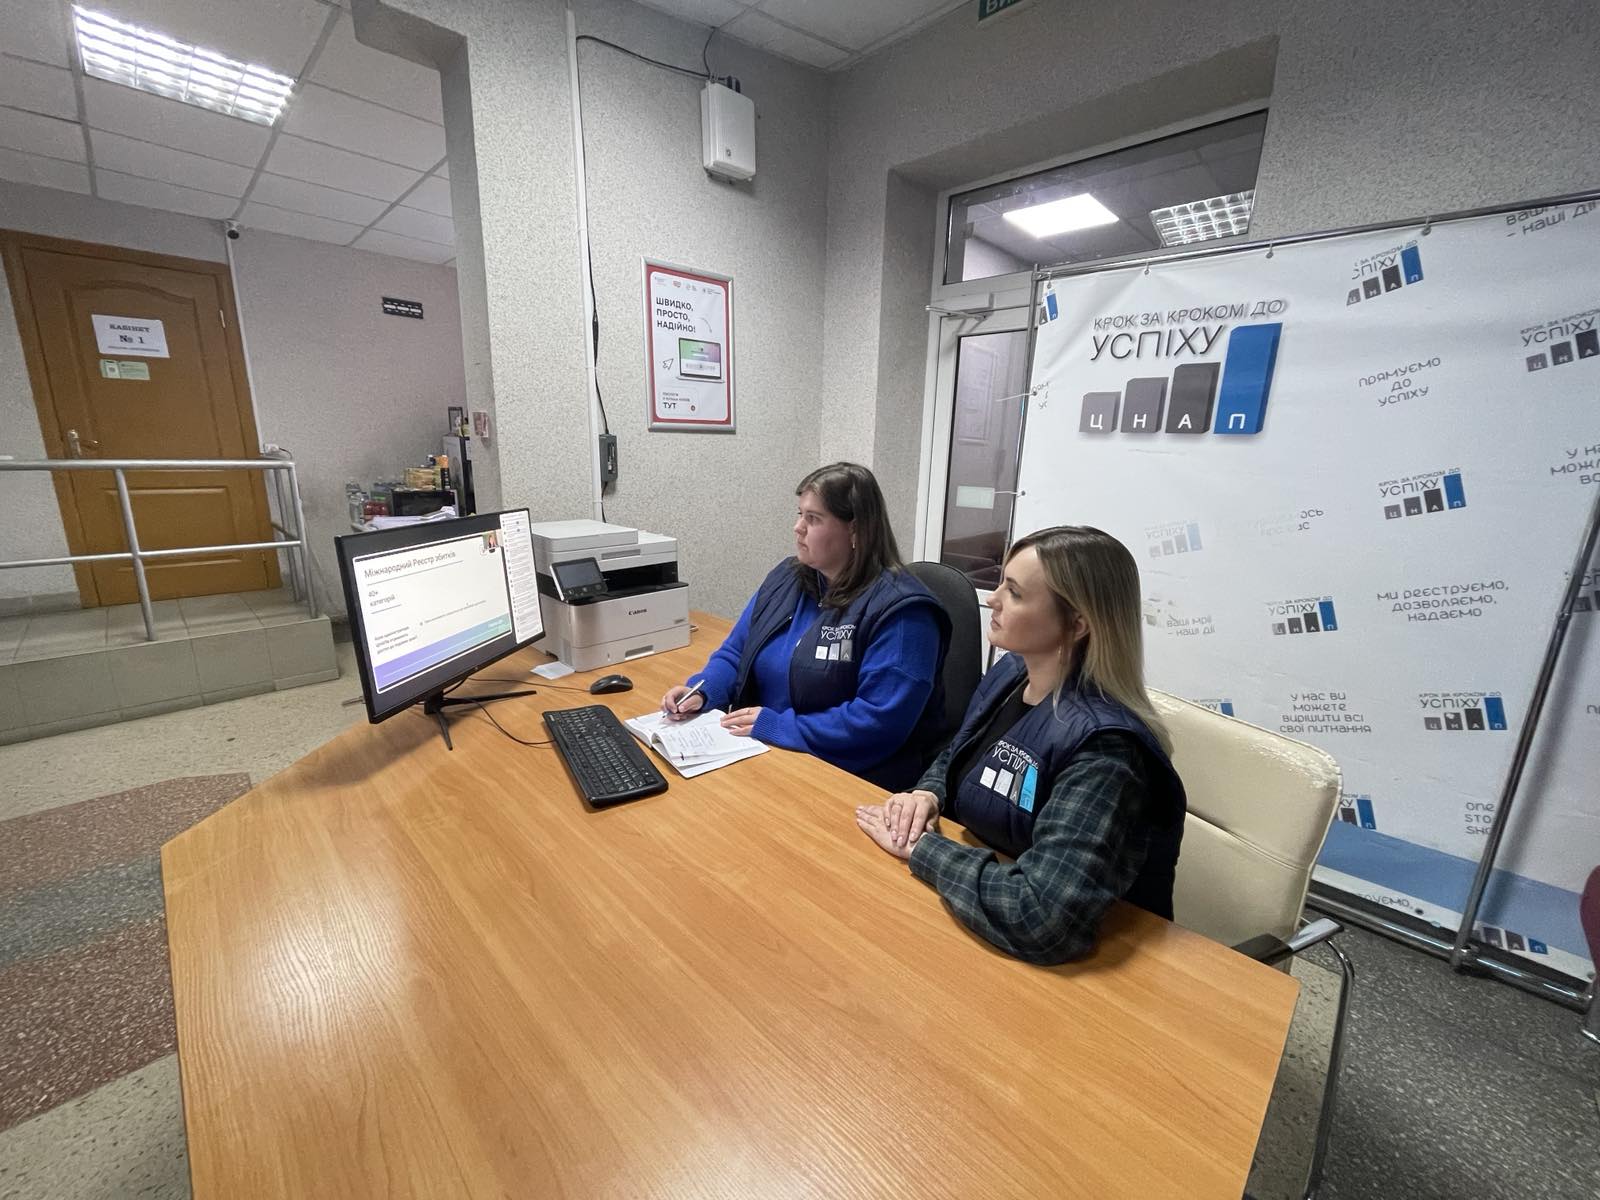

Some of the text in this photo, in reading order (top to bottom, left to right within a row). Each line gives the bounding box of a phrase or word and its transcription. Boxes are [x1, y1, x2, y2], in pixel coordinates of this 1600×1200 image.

[656, 296, 694, 312] ШВИДКО,
[656, 308, 691, 323] ПРОСТО,
[1093, 299, 1285, 330] КРОК ЗА КРОКОМ ДО
[657, 319, 696, 334] НАДІЙНО!
[1521, 316, 1595, 347] УСПІХУ
[1090, 324, 1226, 361] УСПІХУ
[663, 401, 677, 409] ТУТ
[1380, 478, 1439, 498] УСПІХУ
[1420, 698, 1480, 709] УСПІХУ
[1464, 813, 1492, 824] STO
